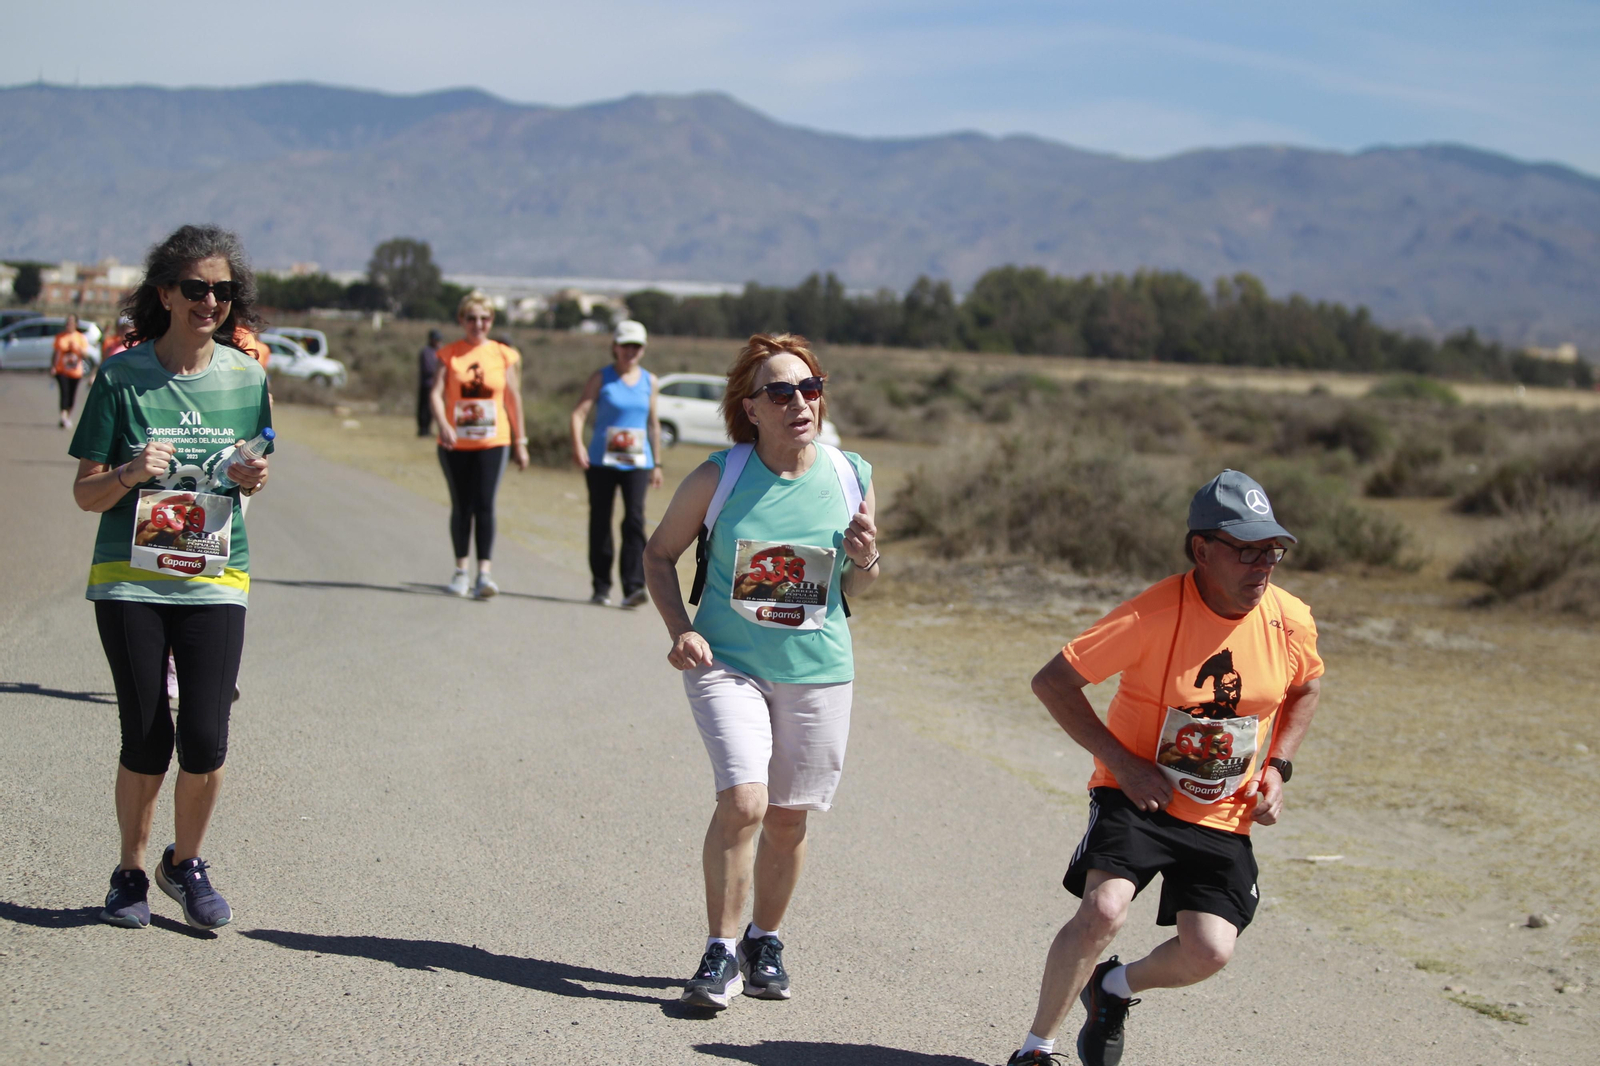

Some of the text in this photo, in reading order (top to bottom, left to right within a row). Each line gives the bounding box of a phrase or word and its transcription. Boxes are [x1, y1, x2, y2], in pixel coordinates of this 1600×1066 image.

[180, 411, 201, 425] XII
[146, 427, 235, 436] CARRERA POPULAR
[151, 504, 205, 532] 639
[748, 555, 806, 583] 536
[786, 581, 818, 590] XIII
[1175, 727, 1234, 760] 613
[1214, 757, 1245, 766] XIII
